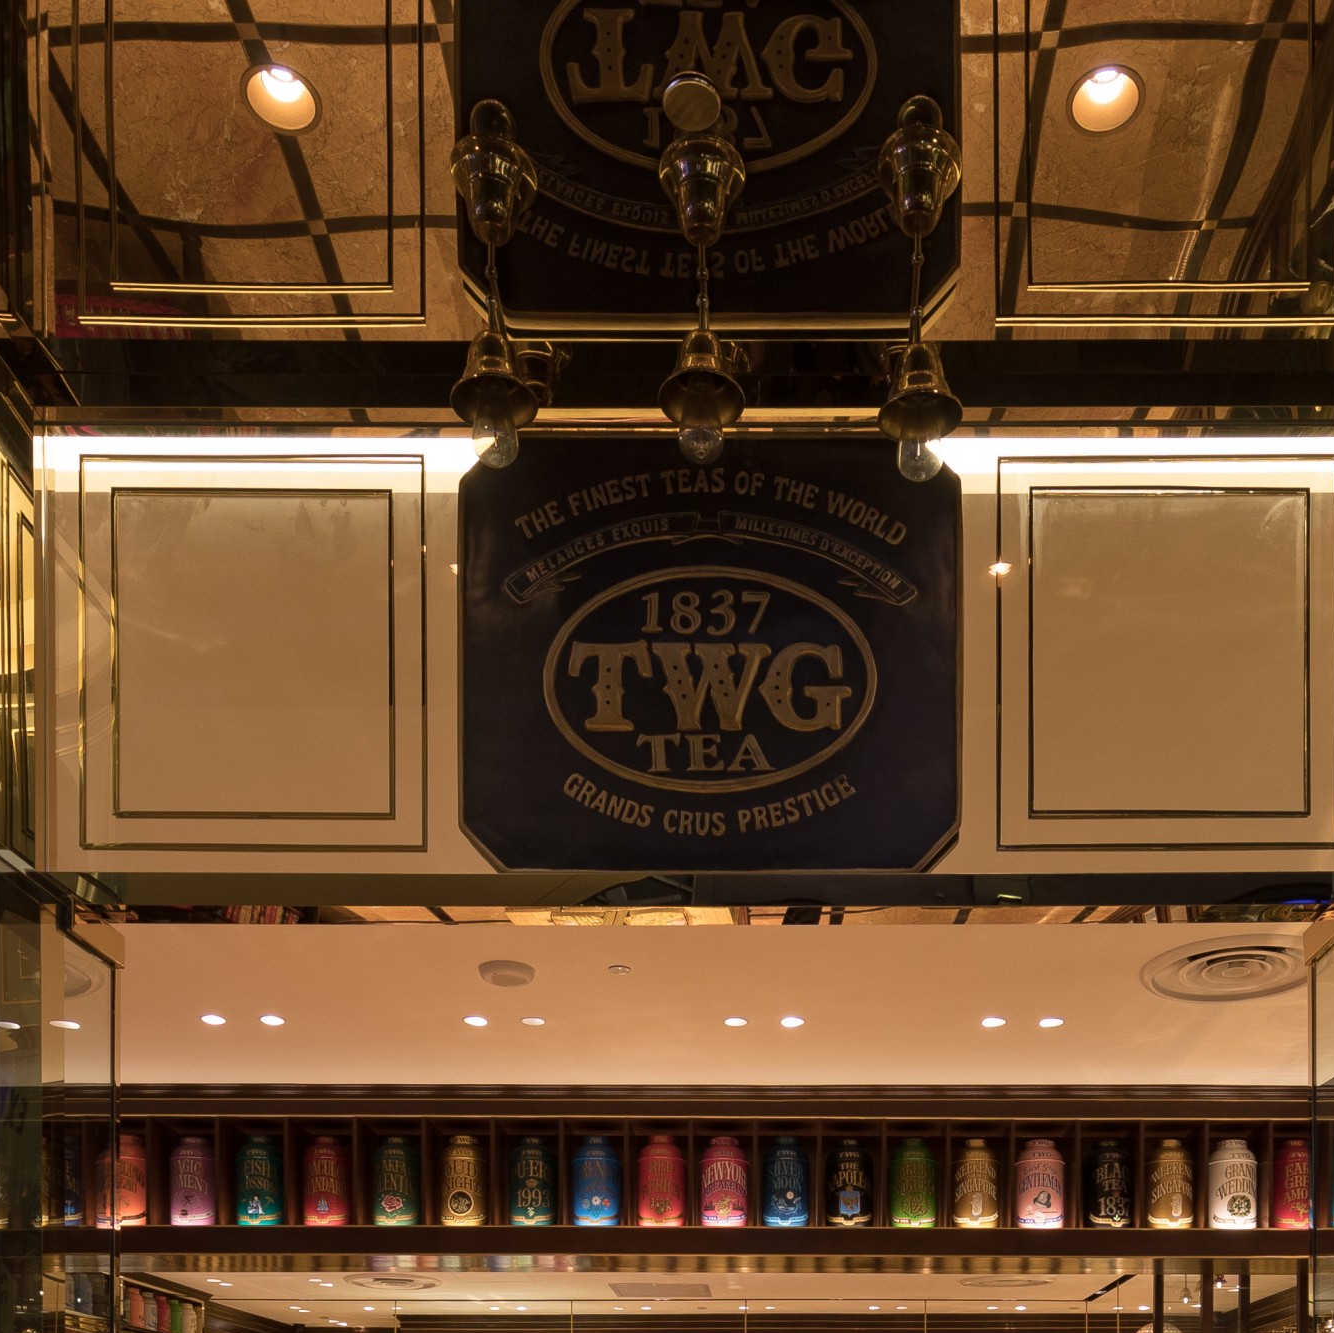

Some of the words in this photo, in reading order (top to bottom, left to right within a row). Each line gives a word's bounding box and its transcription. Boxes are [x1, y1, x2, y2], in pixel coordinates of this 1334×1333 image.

[514, 501, 565, 540] THE
[567, 473, 651, 519] FINEST
[660, 468, 726, 495] TEAS
[734, 470, 765, 496] OF
[774, 477, 819, 511] THE
[827, 491, 907, 546] WORLD
[611, 517, 670, 542] EXQUIS
[734, 515, 818, 549] MILLESIMES
[819, 537, 902, 591] D'EXCEPTION
[641, 590, 771, 636] 1837
[567, 640, 853, 732] TWG
[636, 733, 776, 773] TEA
[564, 772, 655, 829] GRANDS
[664, 808, 726, 837] CRUS
[739, 774, 857, 833] PRESTIGE
[955, 1162, 996, 1182] WEEKEND
[1101, 1178, 1128, 1192] TEA
[516, 1187, 550, 1208] 1993
